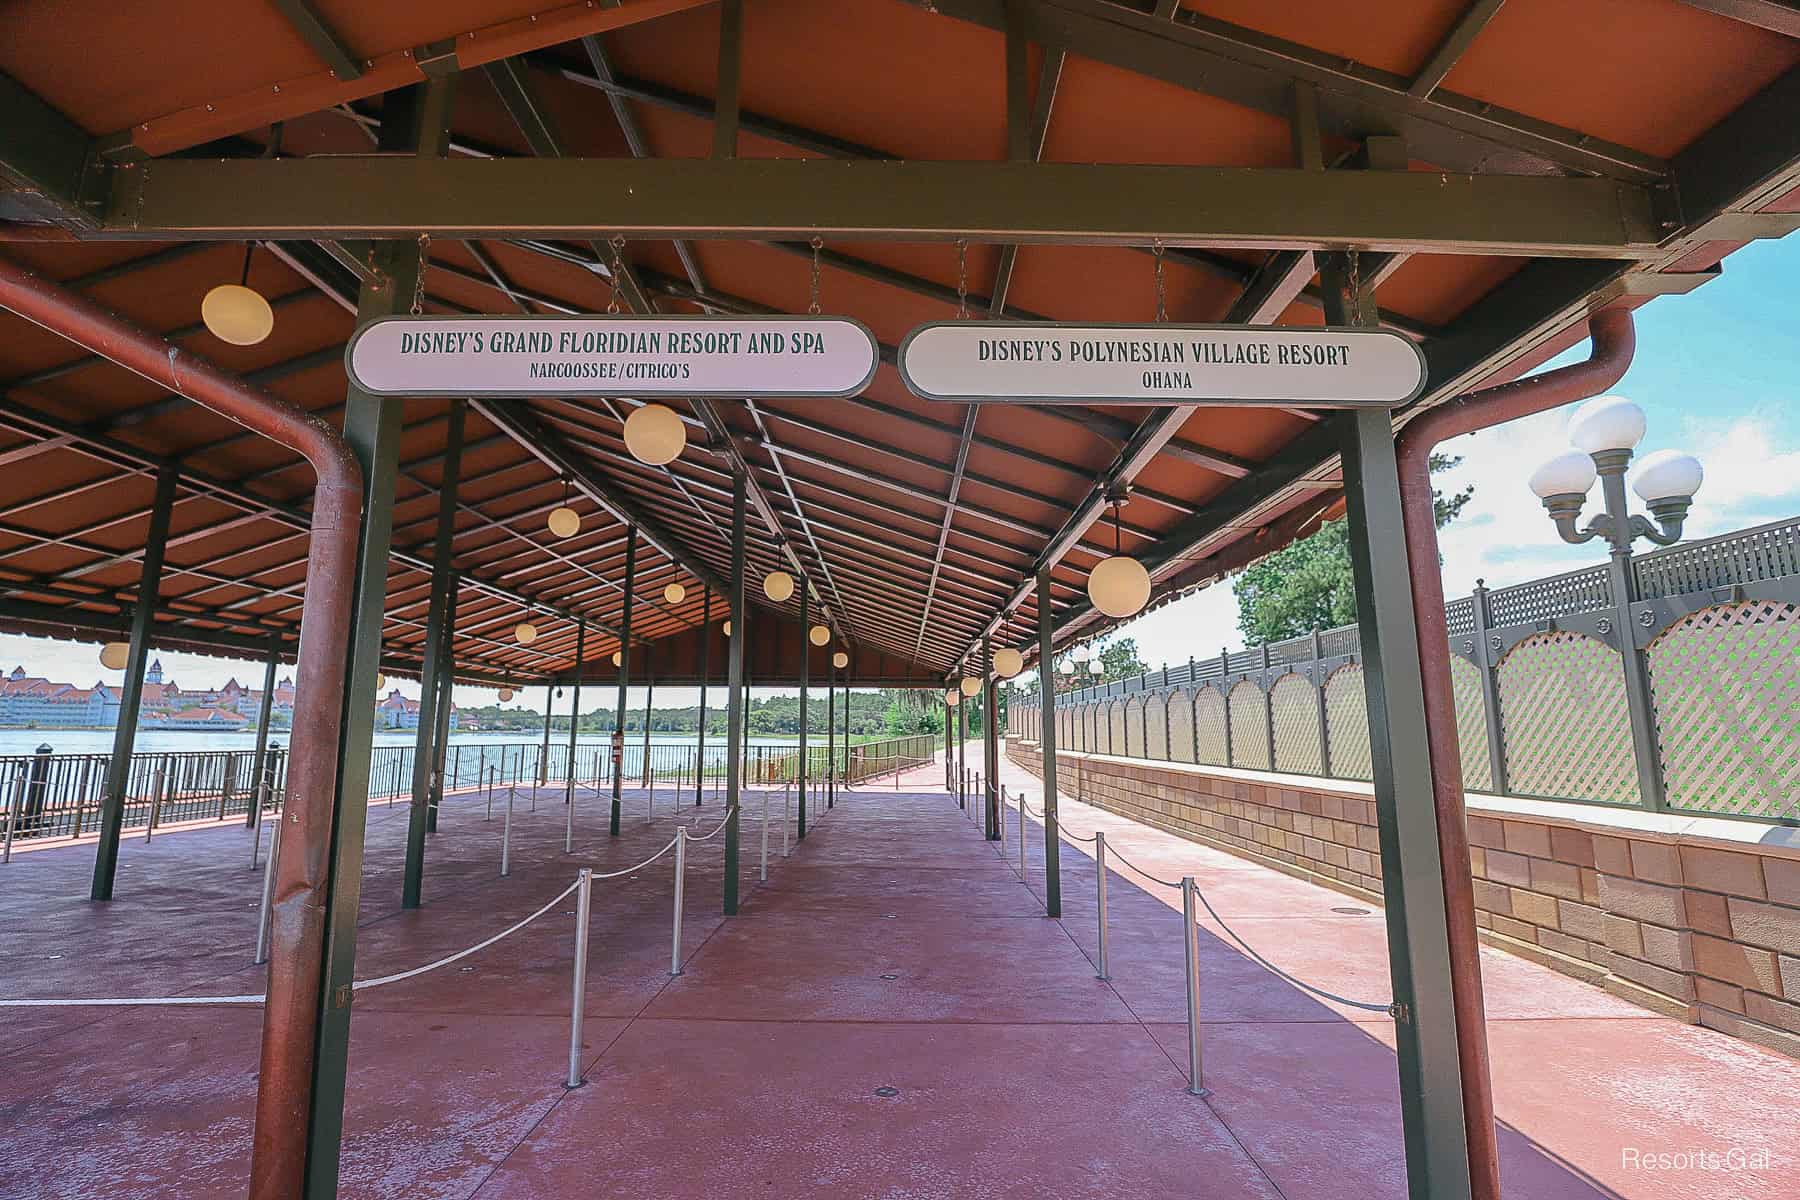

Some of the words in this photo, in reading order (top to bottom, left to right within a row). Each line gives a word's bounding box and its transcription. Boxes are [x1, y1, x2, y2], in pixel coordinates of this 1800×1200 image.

[400, 331, 484, 354] DISNEY'S
[490, 332, 553, 354] GRAND
[559, 332, 660, 355] FLORIDIAN
[667, 333, 742, 355] RESORT
[747, 334, 785, 355] AND
[790, 333, 826, 355] SPA
[978, 340, 1062, 362] DISNEY'S
[1070, 341, 1185, 363] POLYNESIAN
[1192, 343, 1270, 364] VILLAGE
[1278, 344, 1350, 366] RESORT
[529, 362, 690, 380] NARCOOSSEE/CITRICO'S
[1142, 371, 1193, 389] OHANA
